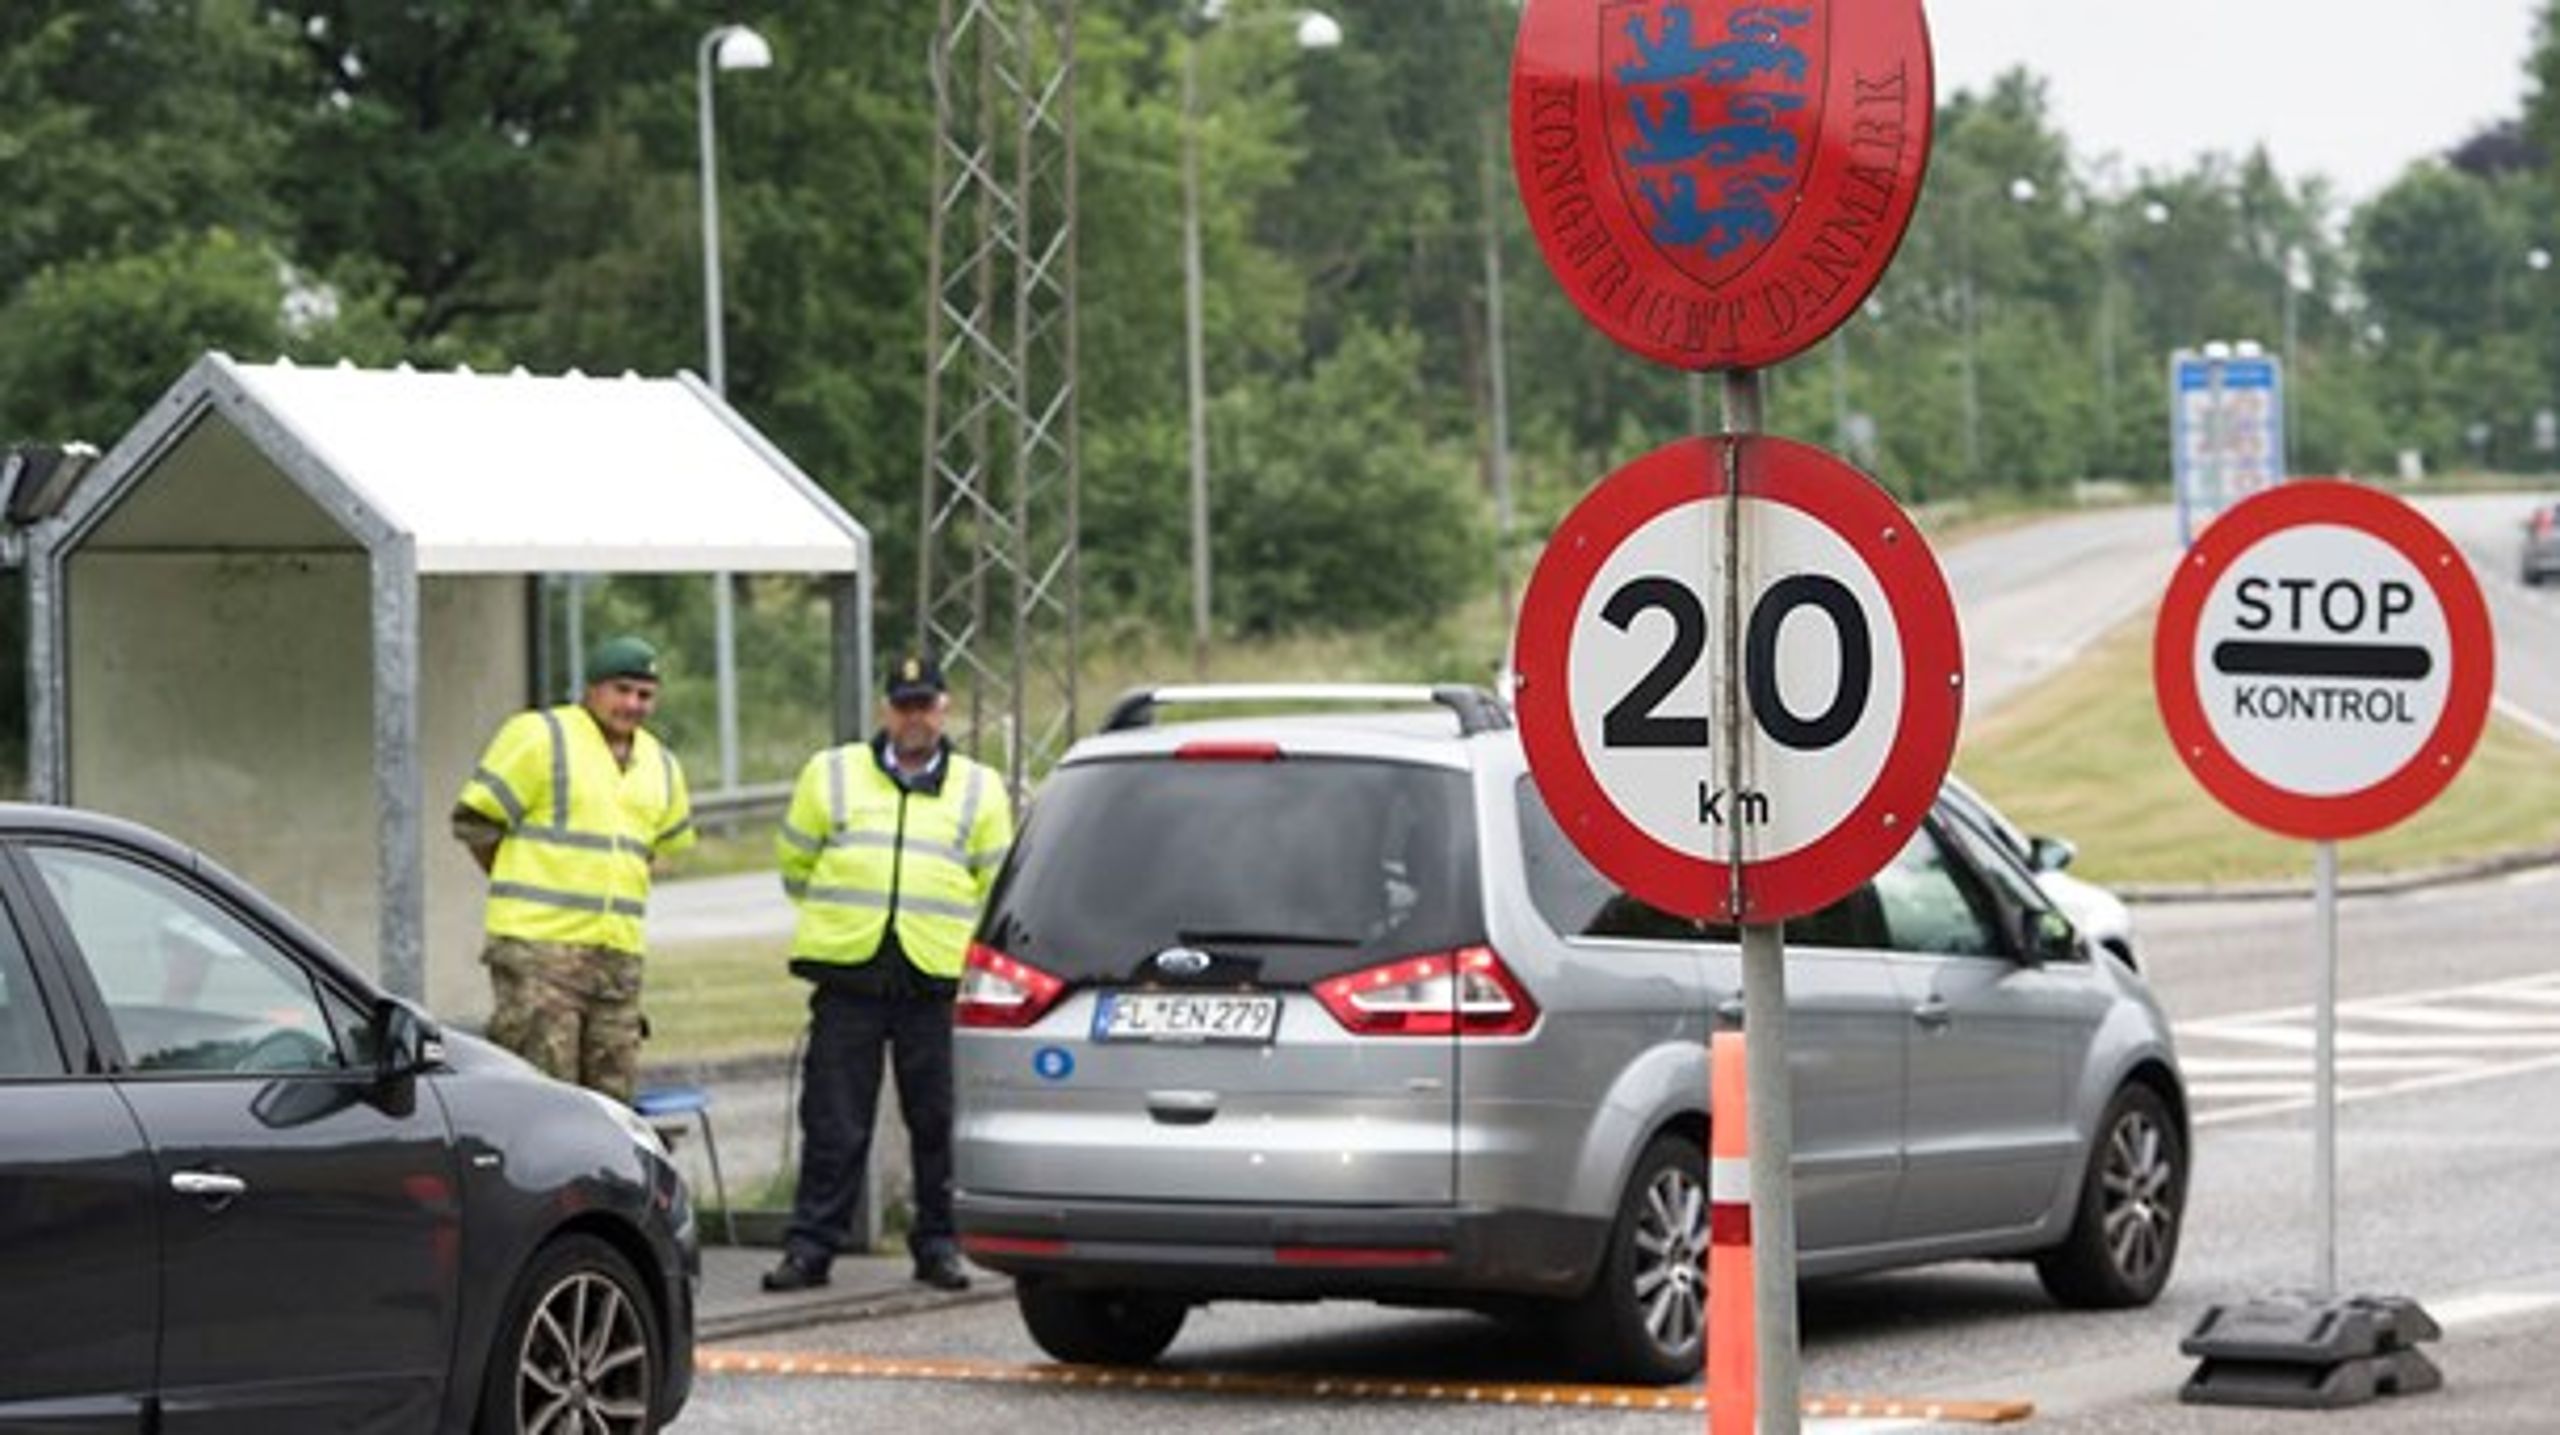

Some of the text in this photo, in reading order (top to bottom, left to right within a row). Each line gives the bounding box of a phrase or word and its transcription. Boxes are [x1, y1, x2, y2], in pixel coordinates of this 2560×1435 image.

[1530, 59, 1909, 352] KONGERIGET DANMARK
[2234, 577, 2415, 634] STOP
[1599, 573, 1873, 752] 20
[2234, 686, 2415, 723] KONTROL
[1698, 781, 1769, 824] km
